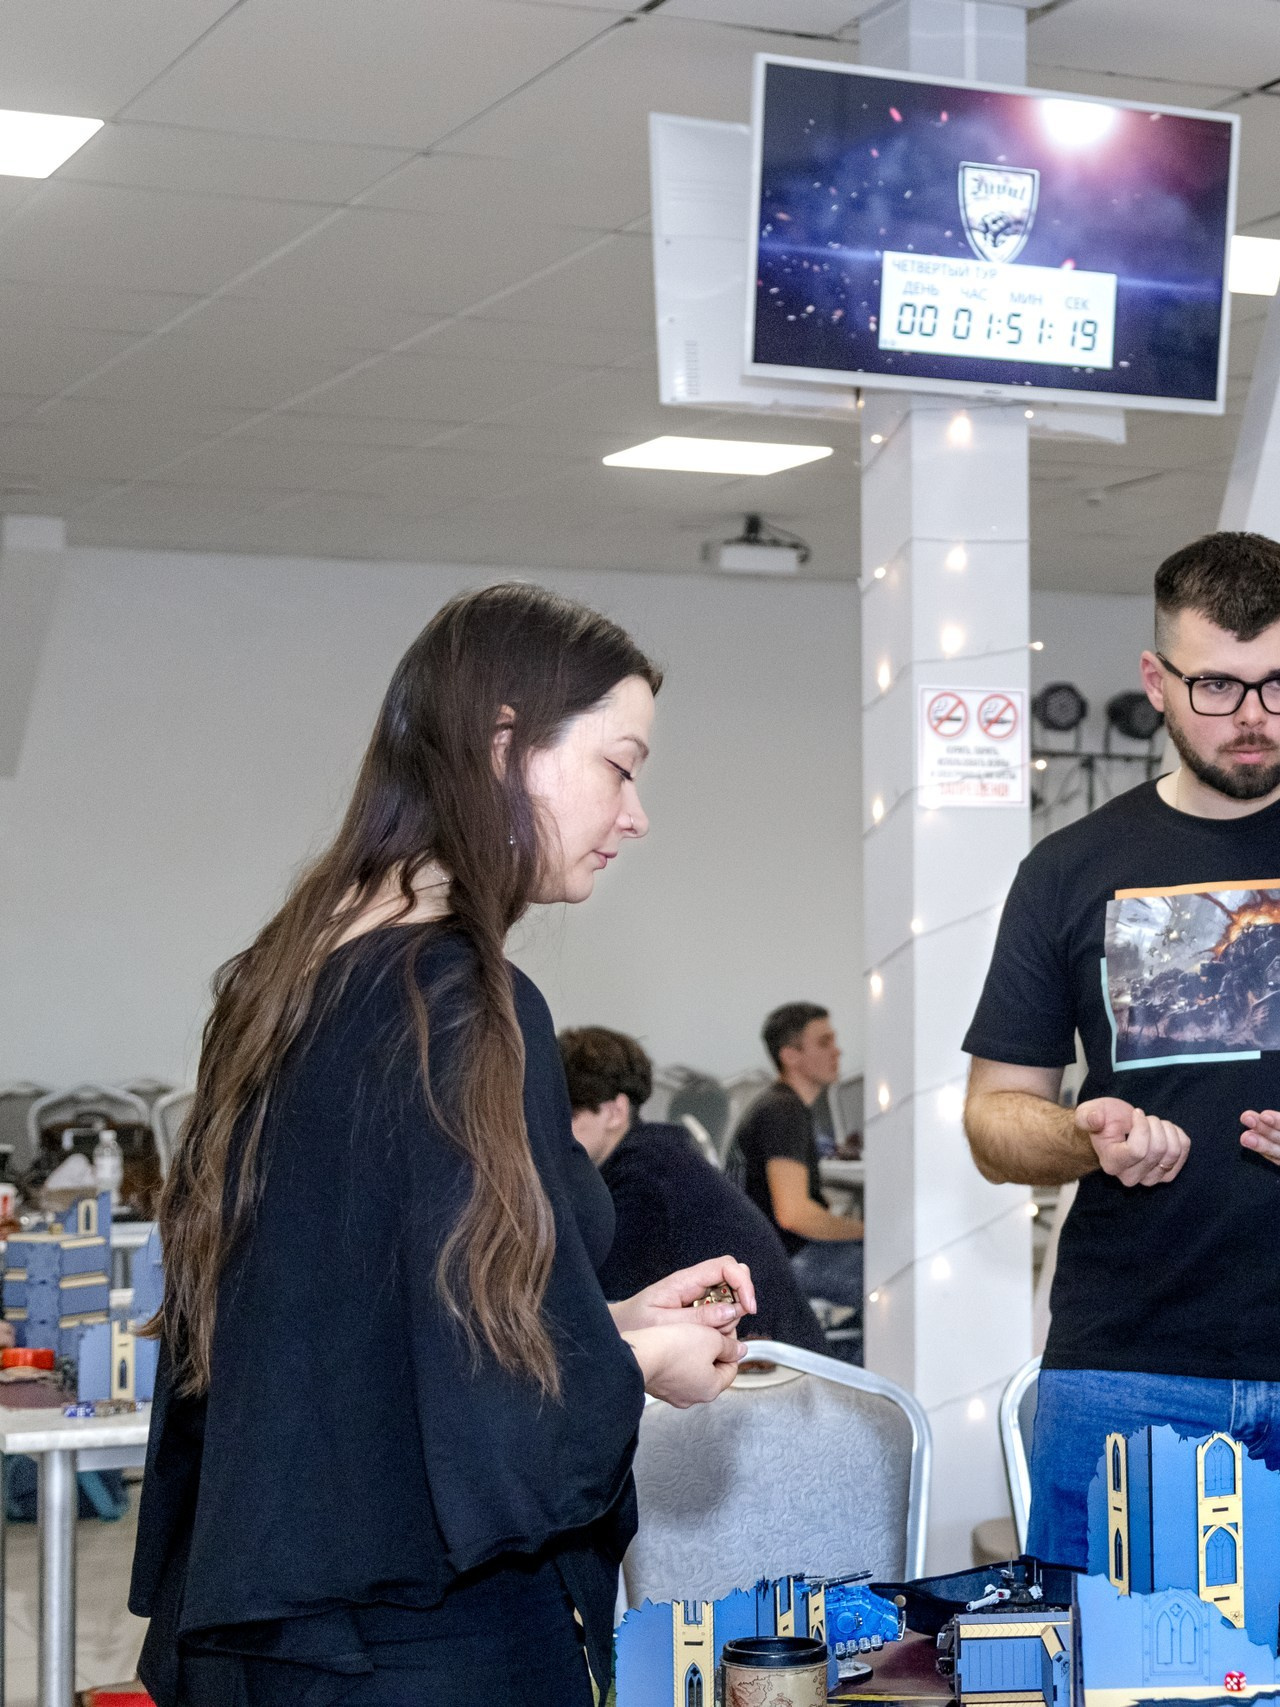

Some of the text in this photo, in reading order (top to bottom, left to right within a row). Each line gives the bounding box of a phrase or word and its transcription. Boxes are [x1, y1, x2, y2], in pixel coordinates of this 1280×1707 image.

[892, 258, 998, 280] ЧЕТВЕРТЫЙ ТУР
[902, 280, 1090, 311] ДЕНЬ ЧАС МИН СЕК
[897, 303, 938, 337] 00
